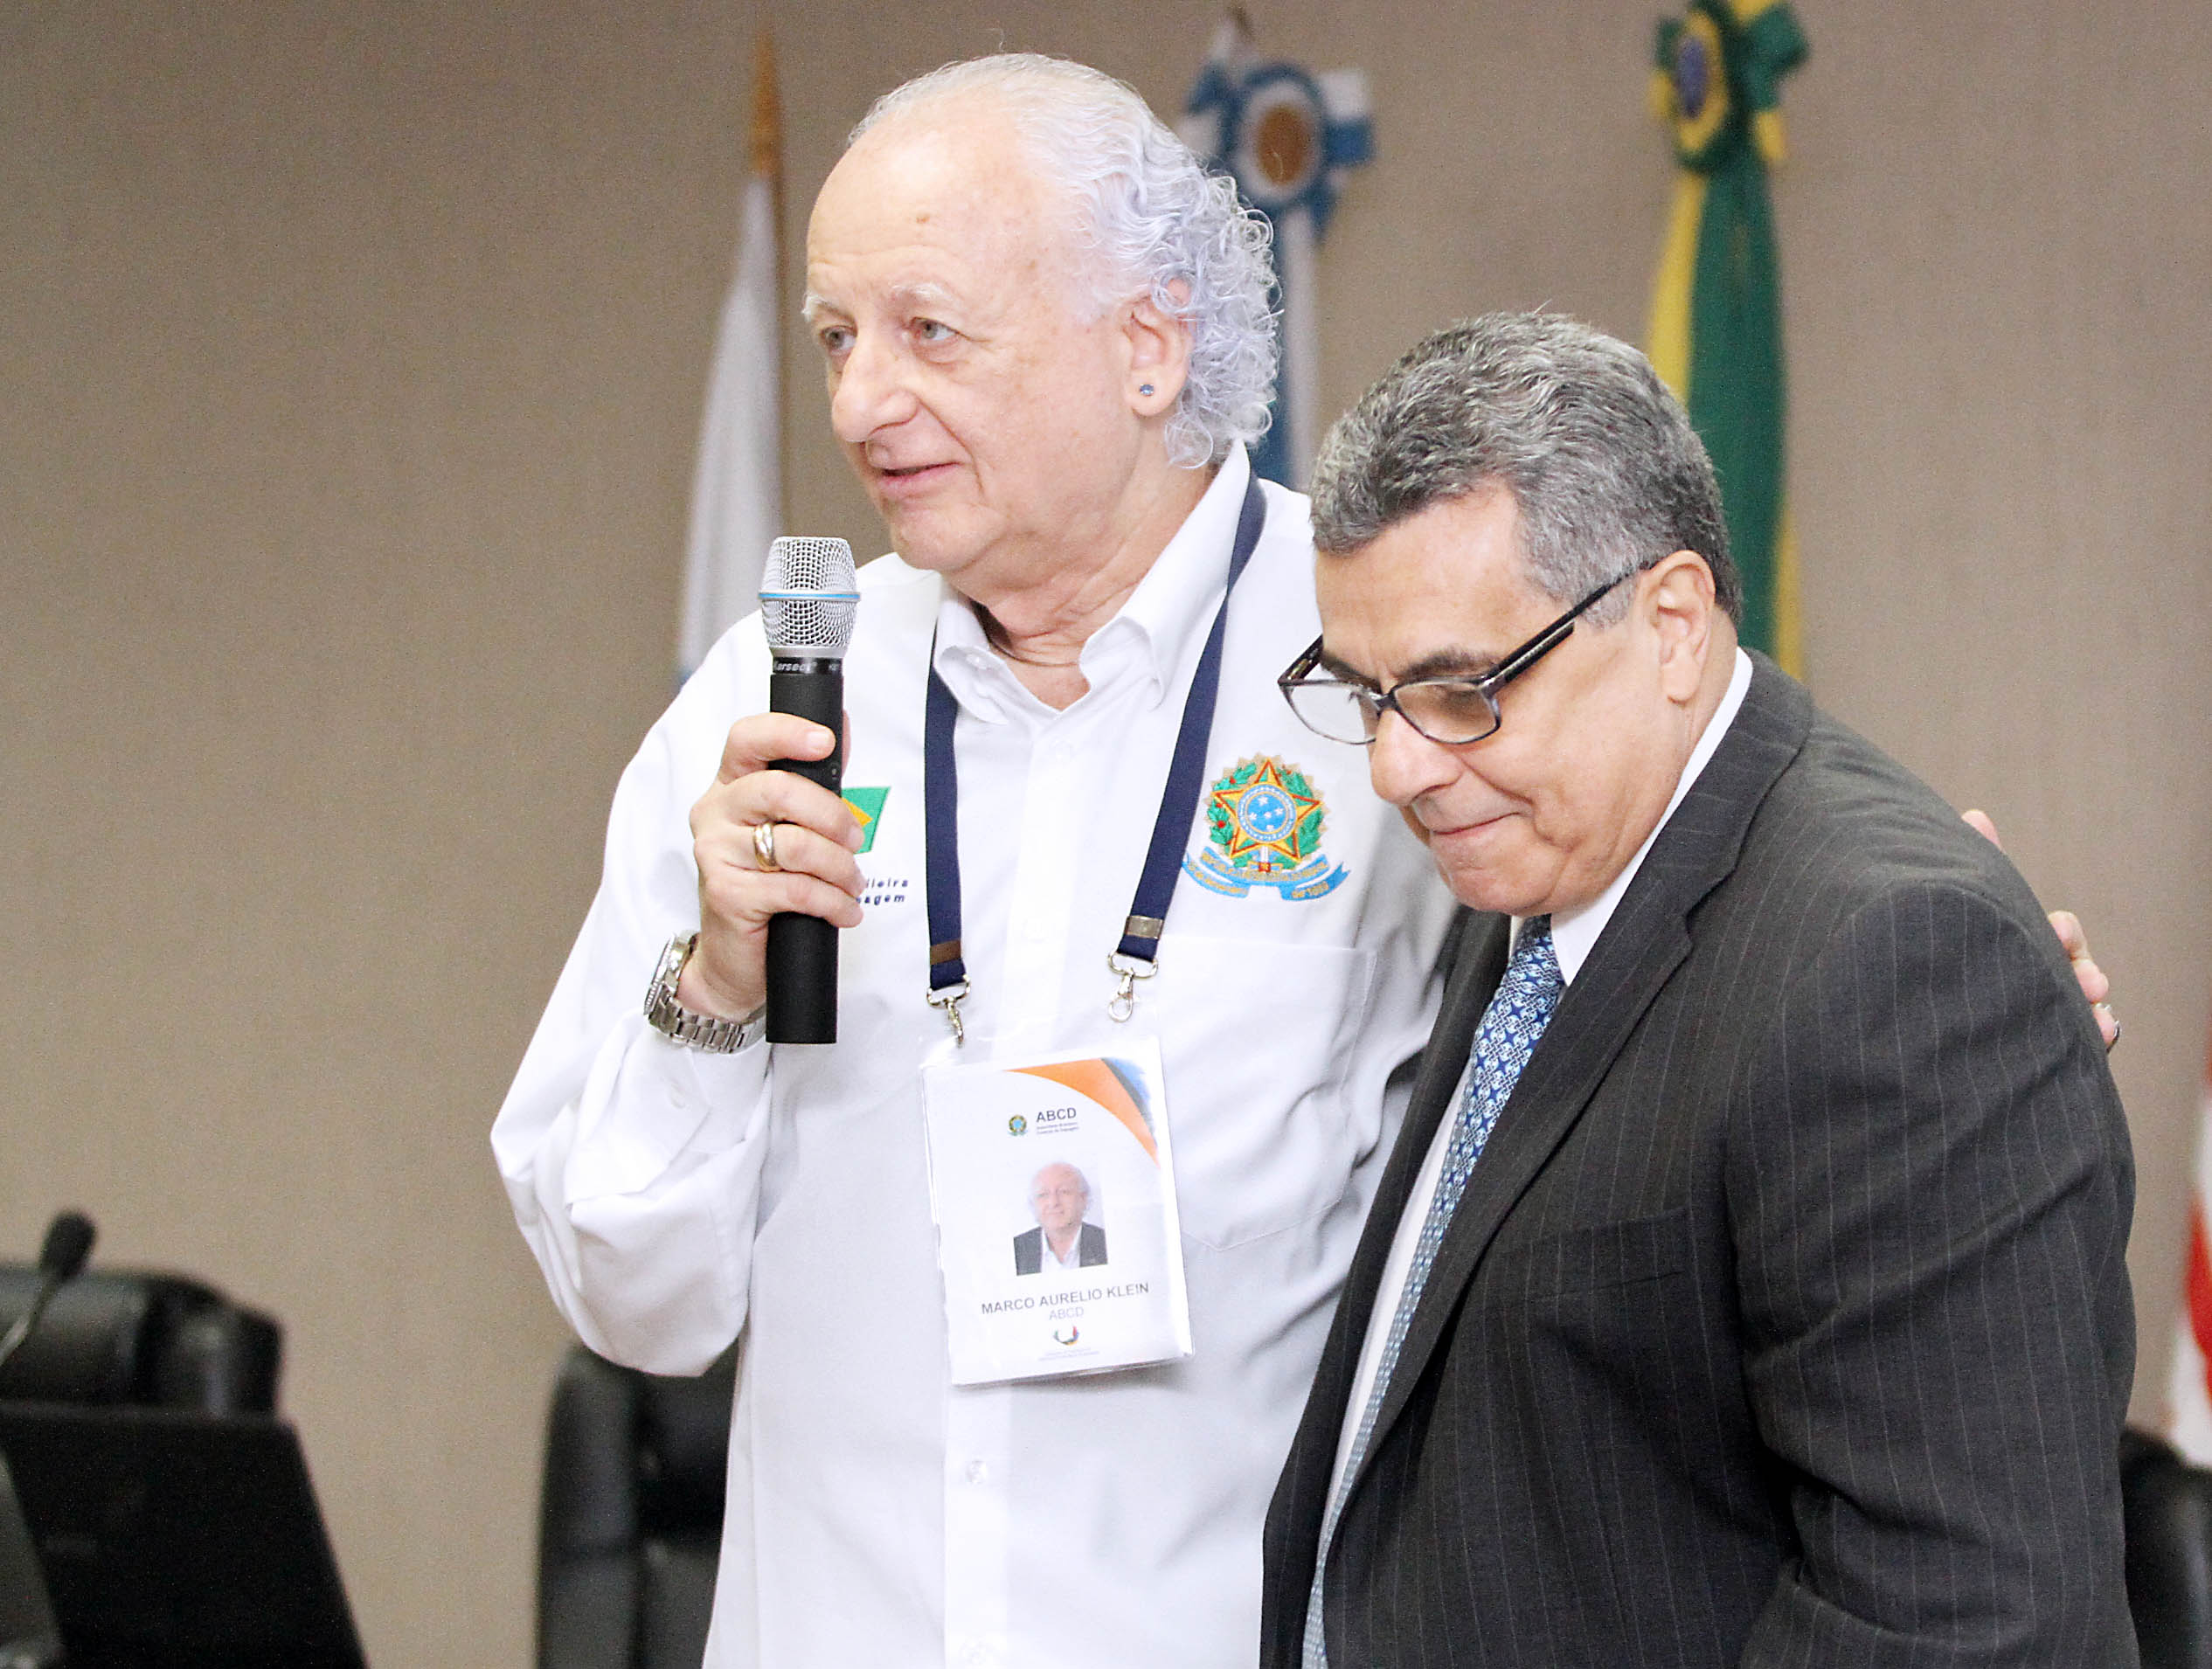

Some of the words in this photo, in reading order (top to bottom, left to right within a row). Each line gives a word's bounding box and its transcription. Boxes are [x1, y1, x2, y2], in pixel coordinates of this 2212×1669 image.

[1037, 1107, 1077, 1123] ABCD
[981, 1297, 1035, 1315] MARCO
[1039, 1288, 1103, 1307] AURELIO
[1107, 1282, 1149, 1298] KLEIN
[1049, 1306, 1085, 1321] ABCD
